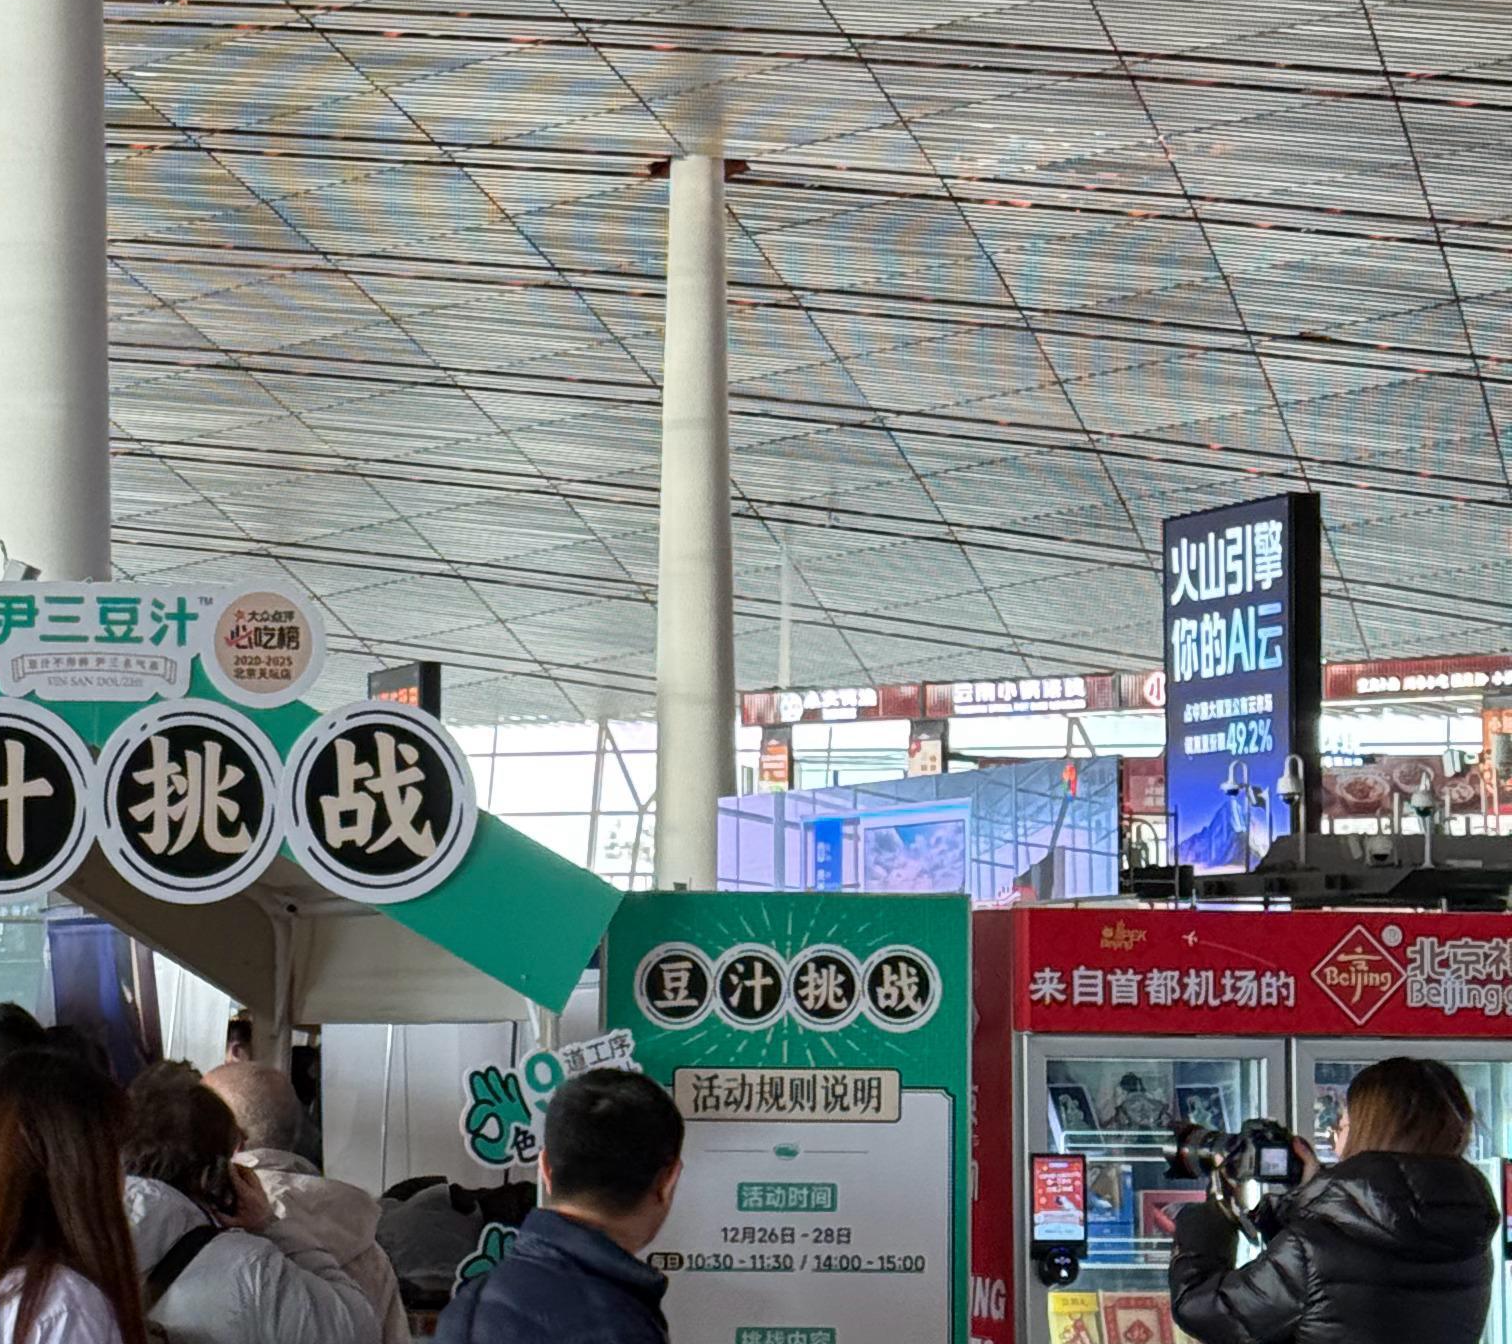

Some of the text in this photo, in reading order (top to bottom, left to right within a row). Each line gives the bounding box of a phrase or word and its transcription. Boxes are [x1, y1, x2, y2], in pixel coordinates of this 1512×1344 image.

[1170, 519, 1284, 607] 火山引擎
[1171, 602, 1284, 683] 你的AI云
[653, 961, 923, 1013] 豆汁挑战
[1029, 967, 1296, 1008] 来自首都机场的
[1407, 978, 1501, 1015] Beijing
[692, 1073, 883, 1113] 活动规则说明
[742, 1186, 833, 1208] 活动时间
